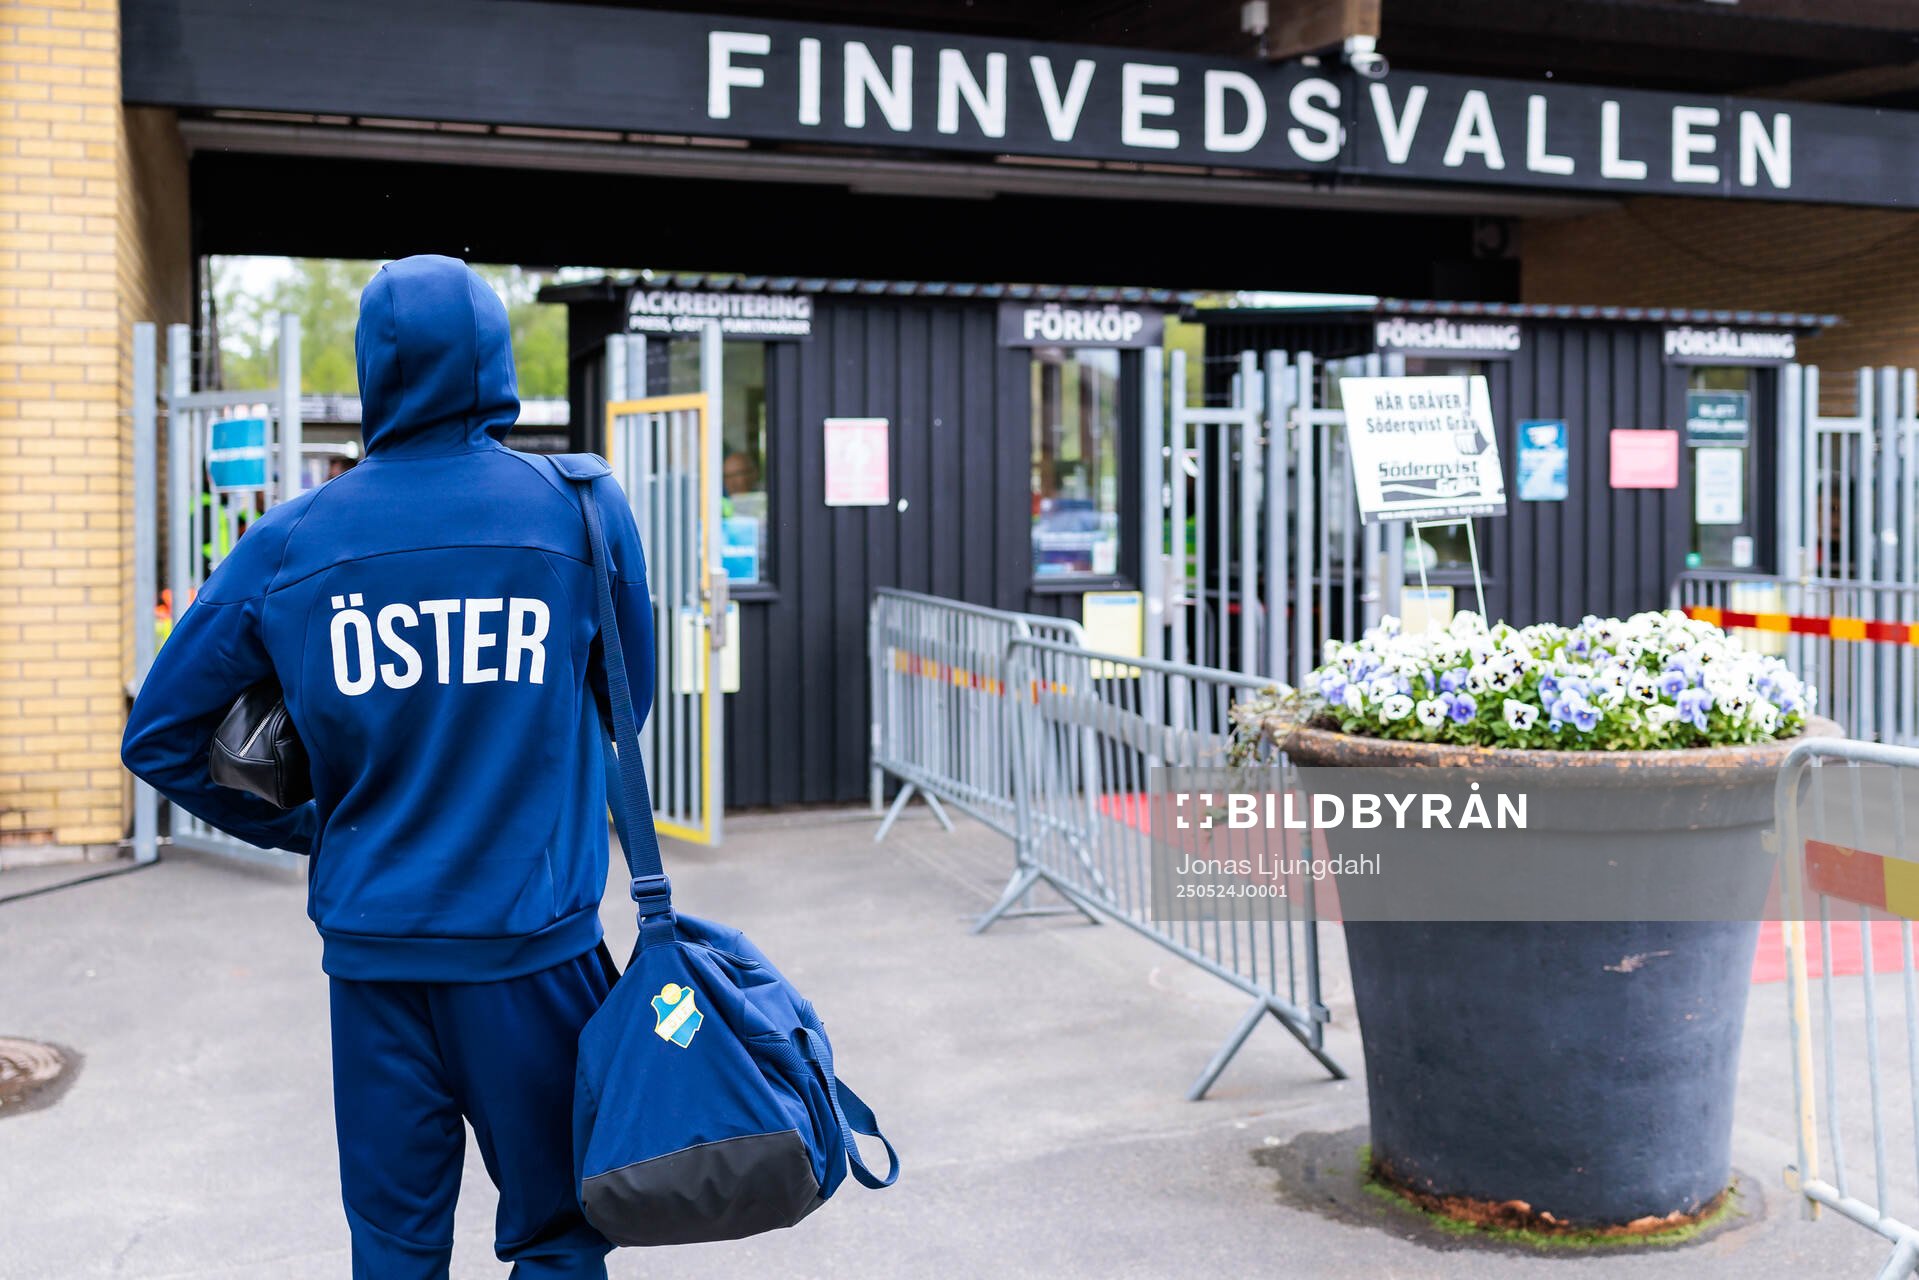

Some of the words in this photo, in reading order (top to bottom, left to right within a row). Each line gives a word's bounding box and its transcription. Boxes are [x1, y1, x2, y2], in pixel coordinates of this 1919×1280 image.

[707, 30, 1793, 189] FINNVEDSVALLEN
[629, 291, 811, 319] ACKREDITERING
[1023, 303, 1143, 341] FÖRKÖP
[1376, 317, 1521, 351] FÖRSÄLJNING
[1375, 391, 1403, 411] HÄR
[1408, 389, 1462, 410] GRÄVER
[1366, 416, 1442, 434] Söderqvist
[1378, 460, 1479, 479] Söderqvist
[329, 592, 551, 697] ÖSTER
